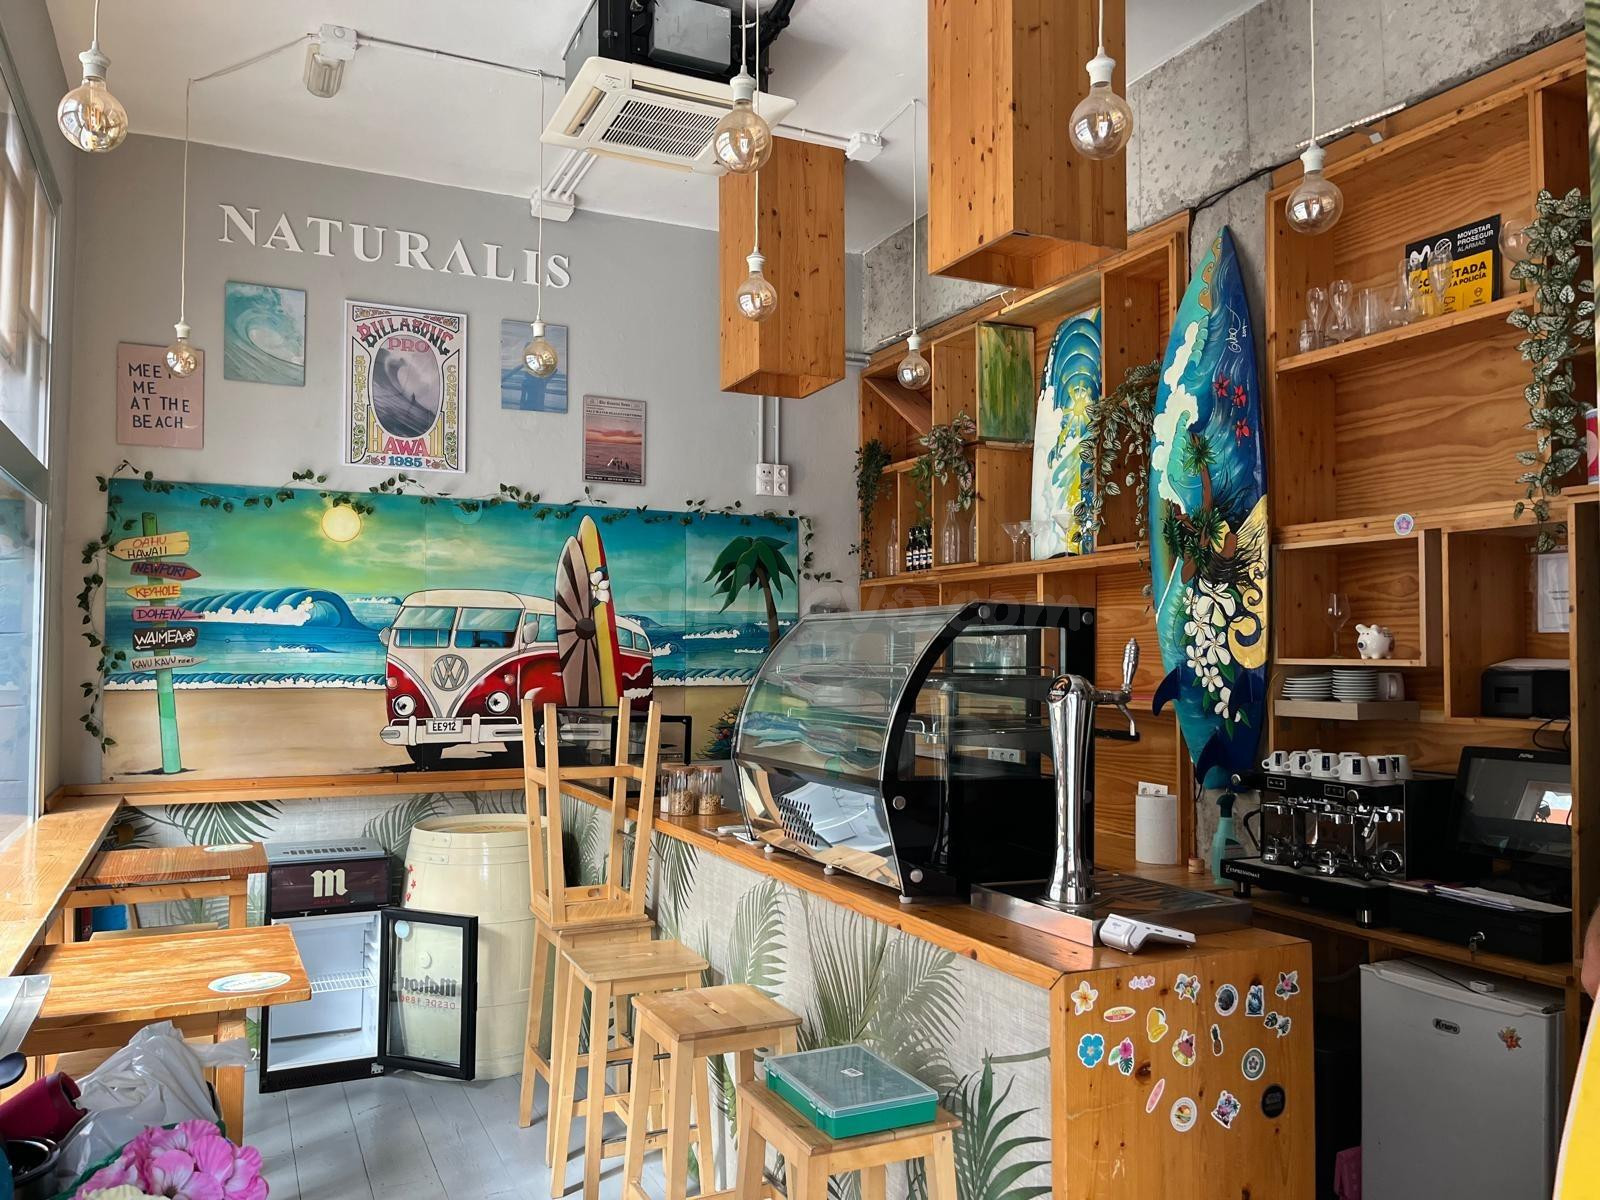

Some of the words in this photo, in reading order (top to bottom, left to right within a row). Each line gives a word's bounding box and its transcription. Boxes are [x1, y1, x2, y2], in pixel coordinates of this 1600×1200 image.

[1457, 223, 1491, 239] MOVISTAR
[1457, 230, 1494, 246] PROSEGUR
[218, 204, 571, 289] NATURALIS
[1457, 239, 1486, 252] ALARMAS
[356, 317, 454, 356] BILLABONG
[387, 336, 430, 353] PRO
[128, 363, 172, 379] MEE
[133, 381, 157, 394] ME
[130, 396, 151, 410] AT
[160, 396, 190, 413] THE
[132, 414, 183, 429] BEACH
[388, 456, 423, 468] 1985
[132, 536, 167, 548] OAHU
[127, 546, 167, 559] HAWAII
[135, 562, 188, 577] NEWPORT
[135, 585, 179, 598] KEYHOLE
[136, 608, 186, 620] DOHENY
[134, 629, 184, 645] WAIMEA
[432, 722, 457, 732] EE912
